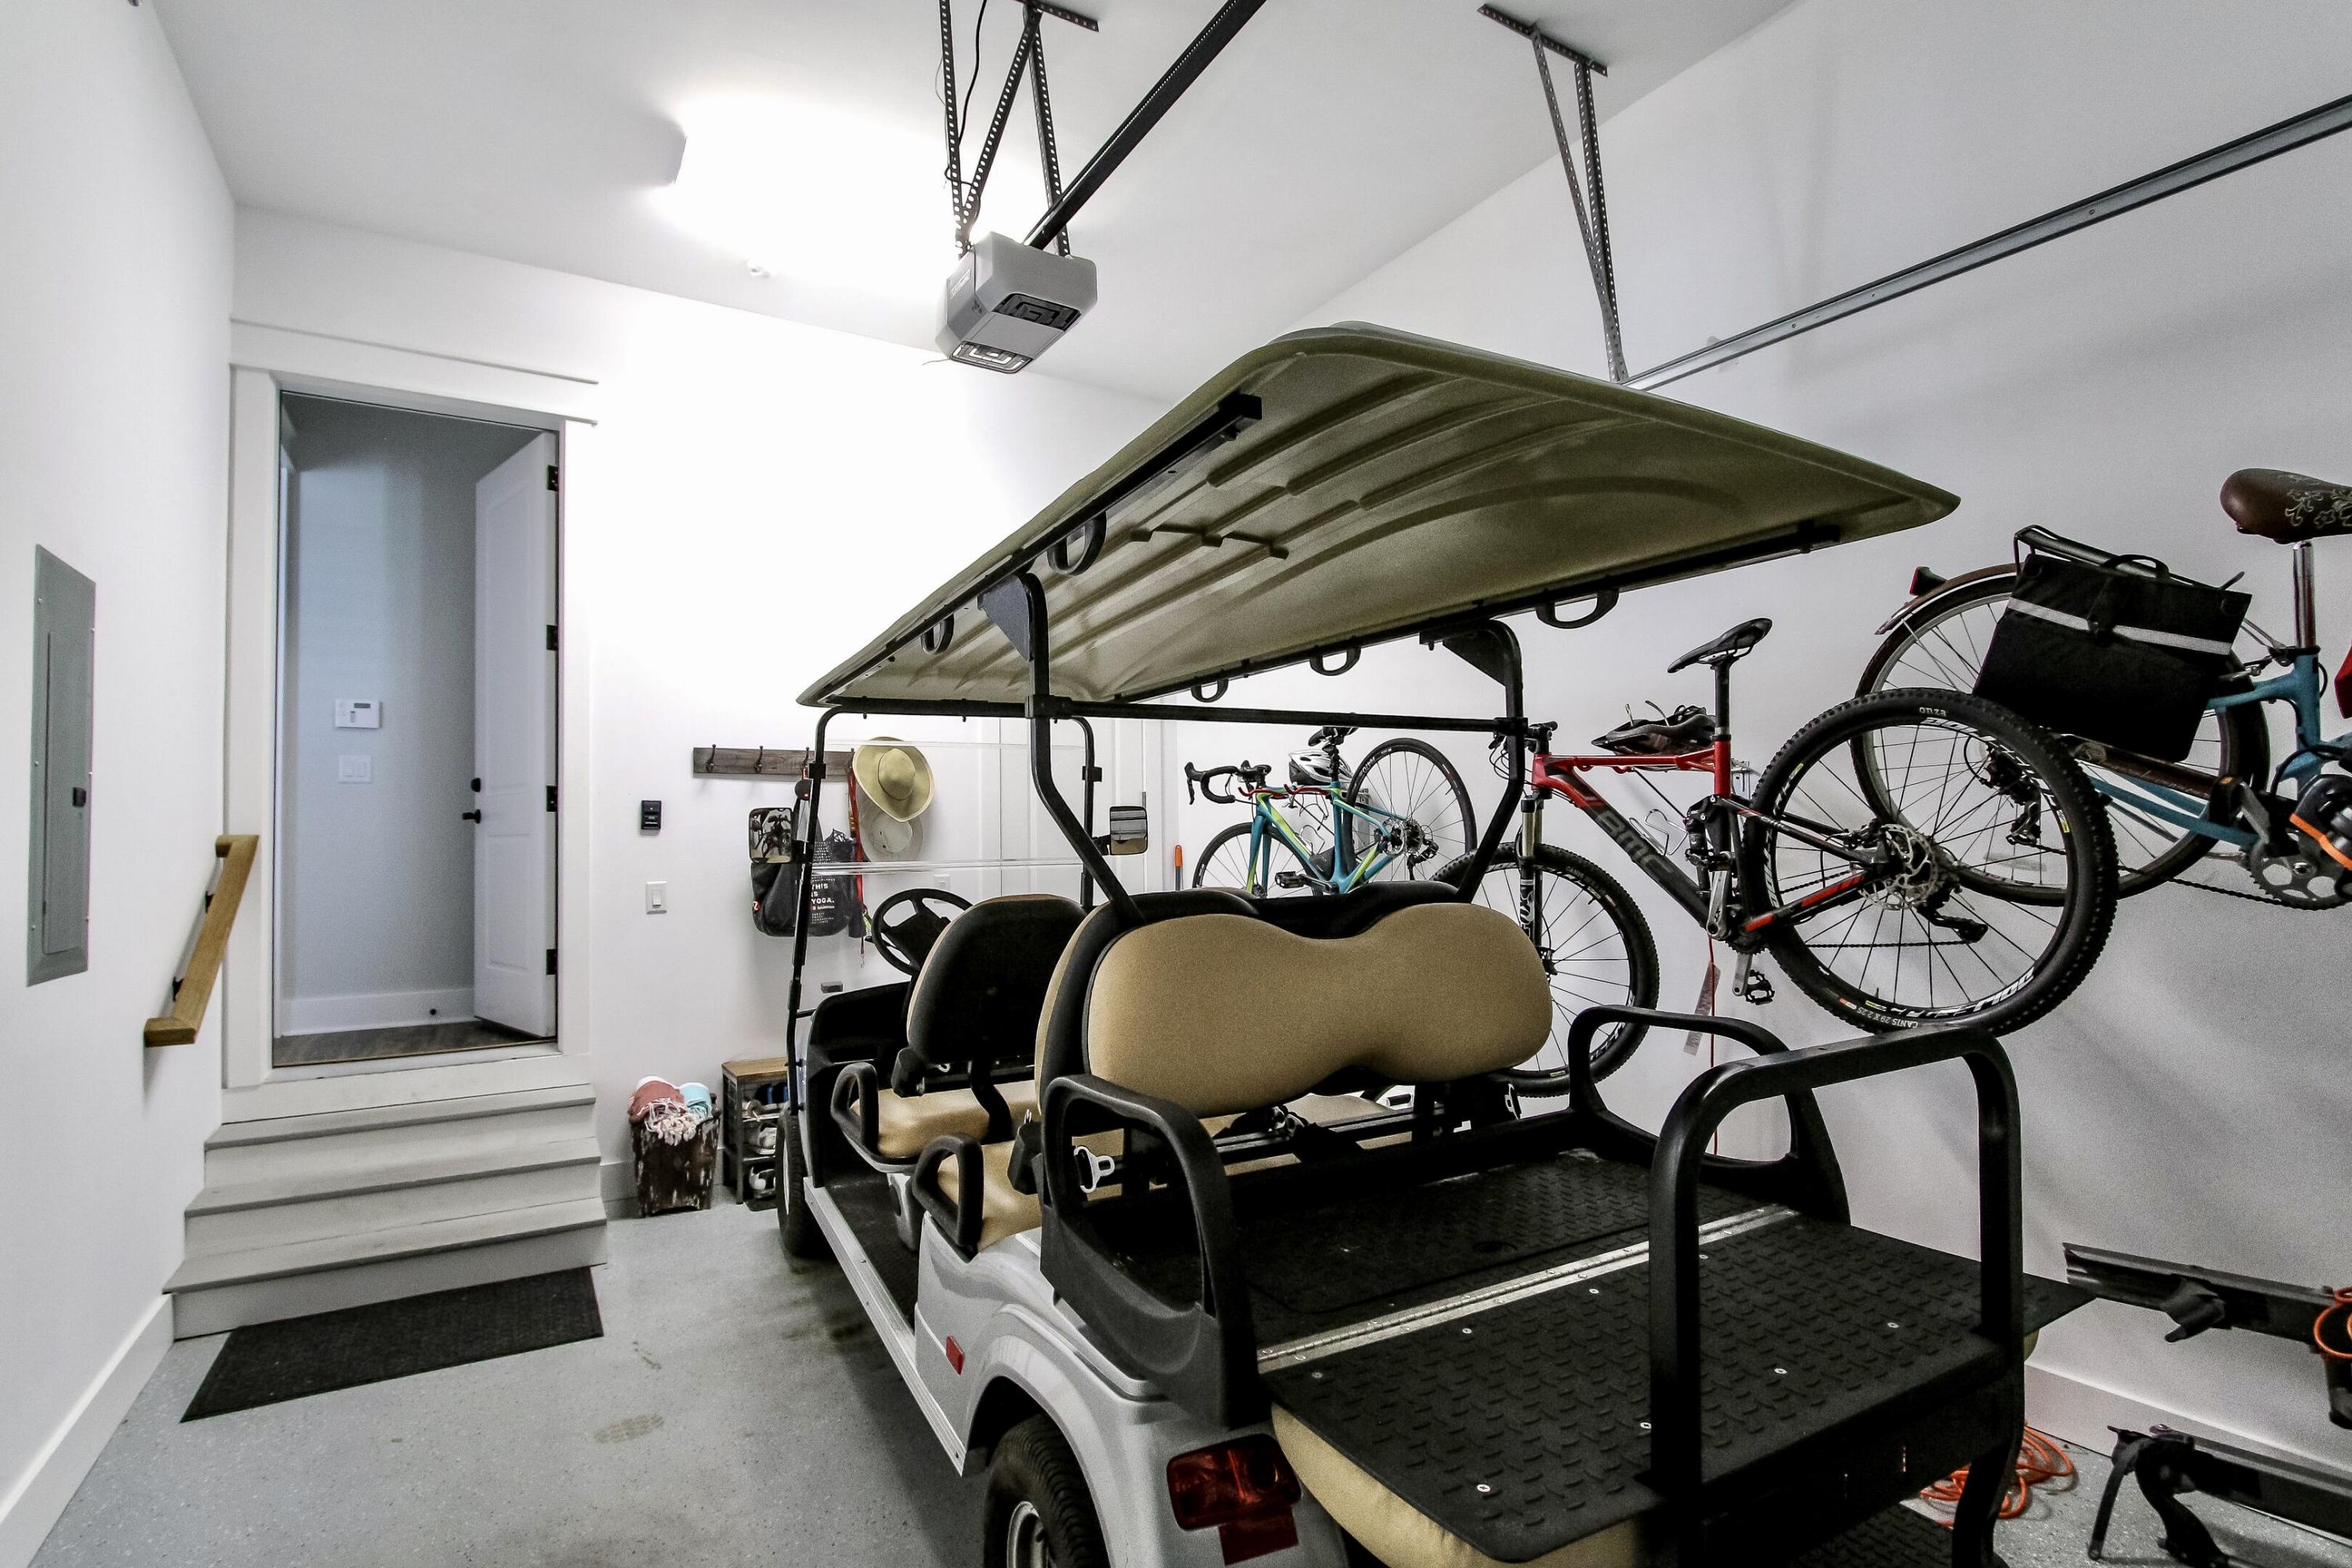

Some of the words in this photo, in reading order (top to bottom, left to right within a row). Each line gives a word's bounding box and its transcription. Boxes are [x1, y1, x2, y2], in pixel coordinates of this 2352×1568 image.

[1919, 706, 1947, 717] onza
[1880, 1015, 1891, 1024] 29
[1892, 1018, 1918, 1029] CANIS
